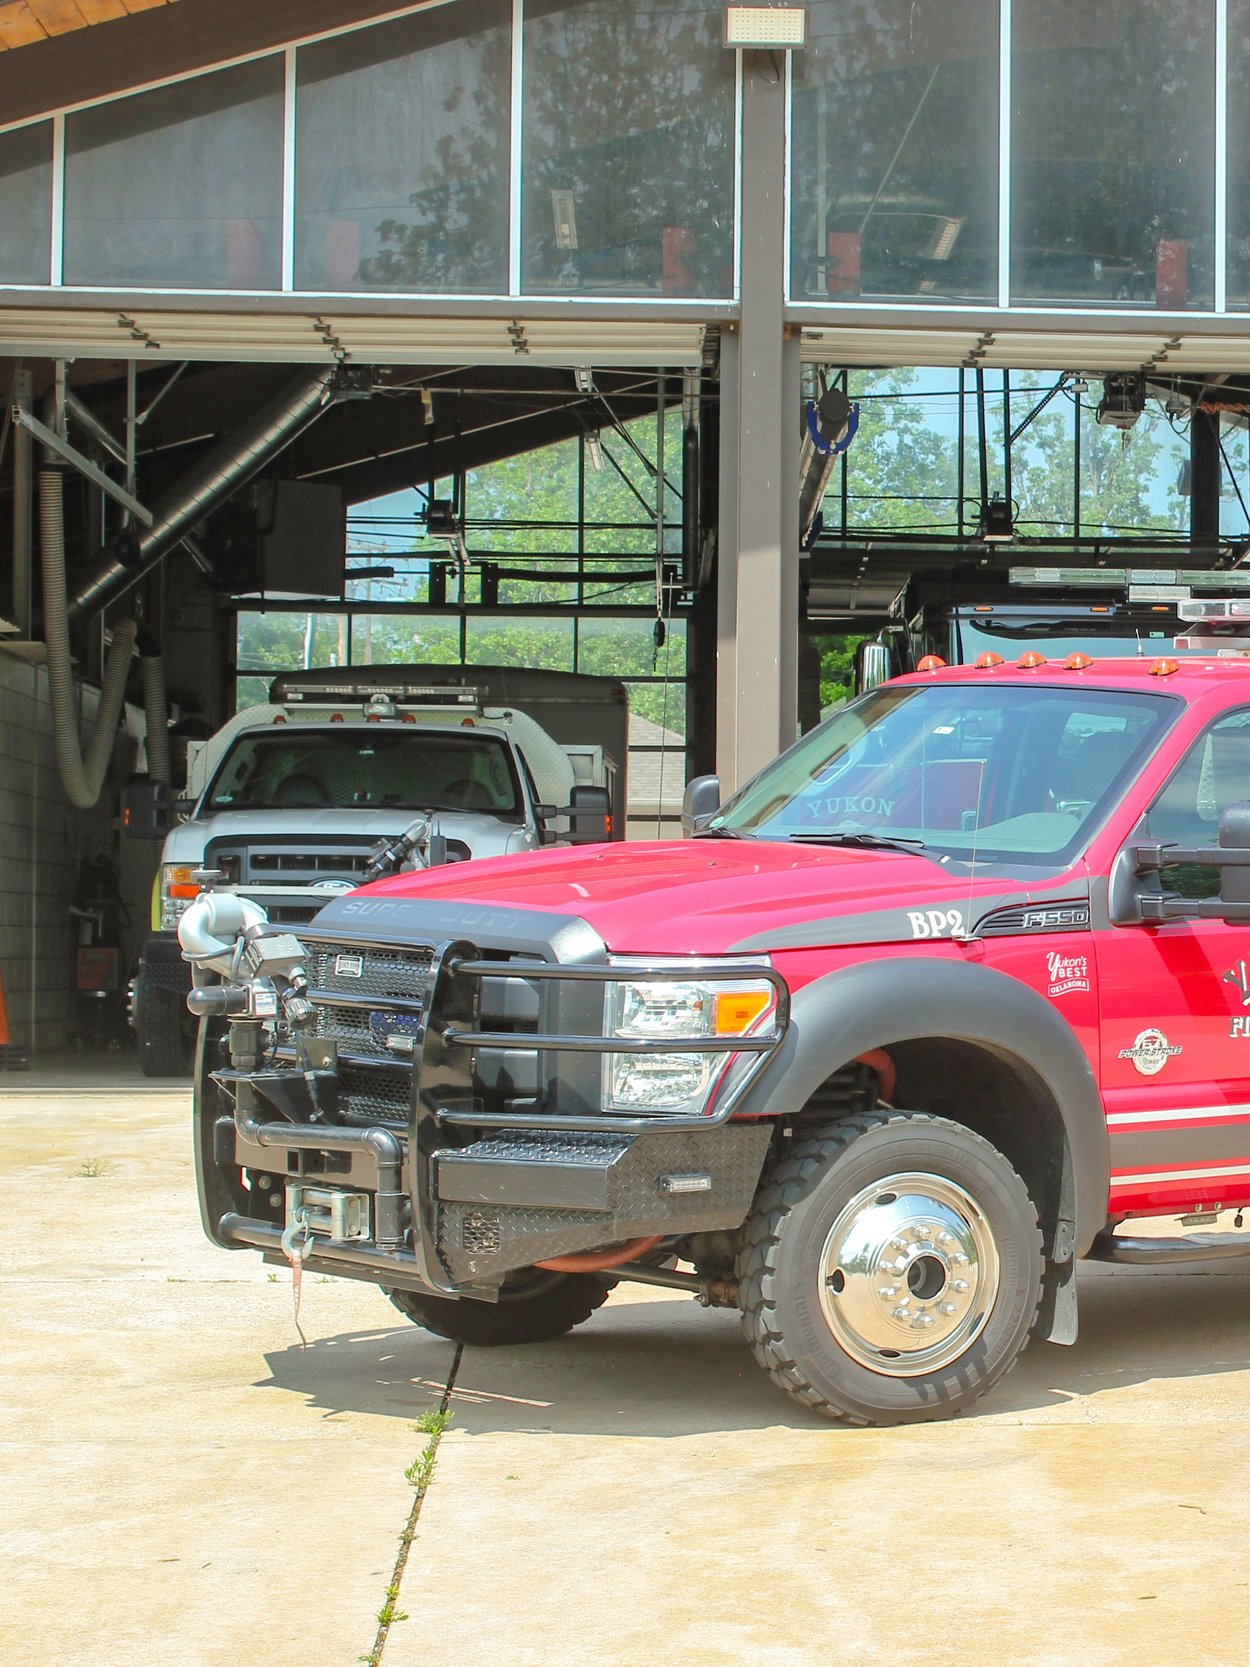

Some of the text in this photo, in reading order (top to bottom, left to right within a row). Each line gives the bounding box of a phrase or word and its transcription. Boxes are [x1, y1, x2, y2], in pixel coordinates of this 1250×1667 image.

[806, 796, 895, 818] YUKON
[907, 909, 965, 938] BP2
[1046, 951, 1087, 982] Yukon's
[1059, 966, 1087, 978] BEST
[1050, 980, 1087, 993] OKLAHOMA
